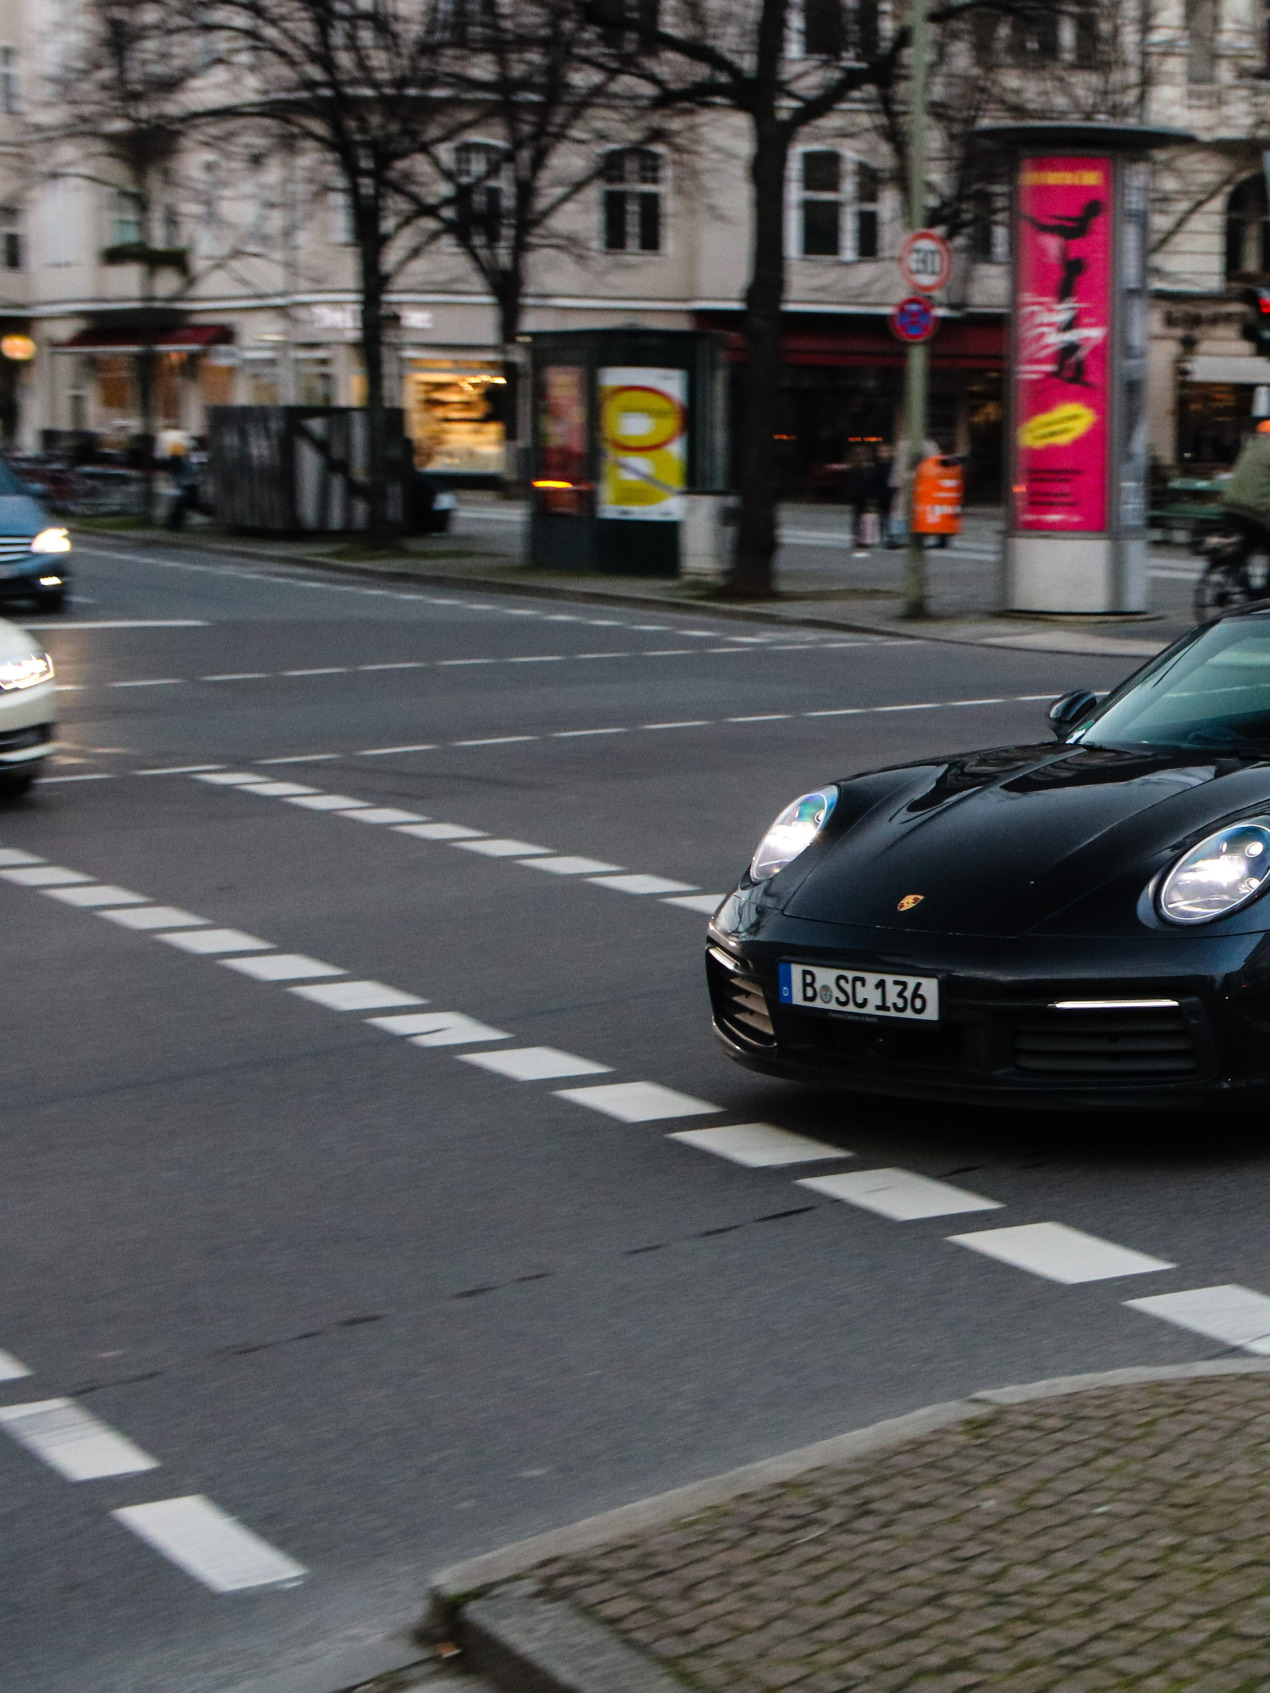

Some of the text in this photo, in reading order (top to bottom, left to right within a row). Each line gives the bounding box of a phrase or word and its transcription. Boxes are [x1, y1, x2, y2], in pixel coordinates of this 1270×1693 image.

[911, 247, 944, 275] 30
[801, 969, 927, 1015] B SC 136
